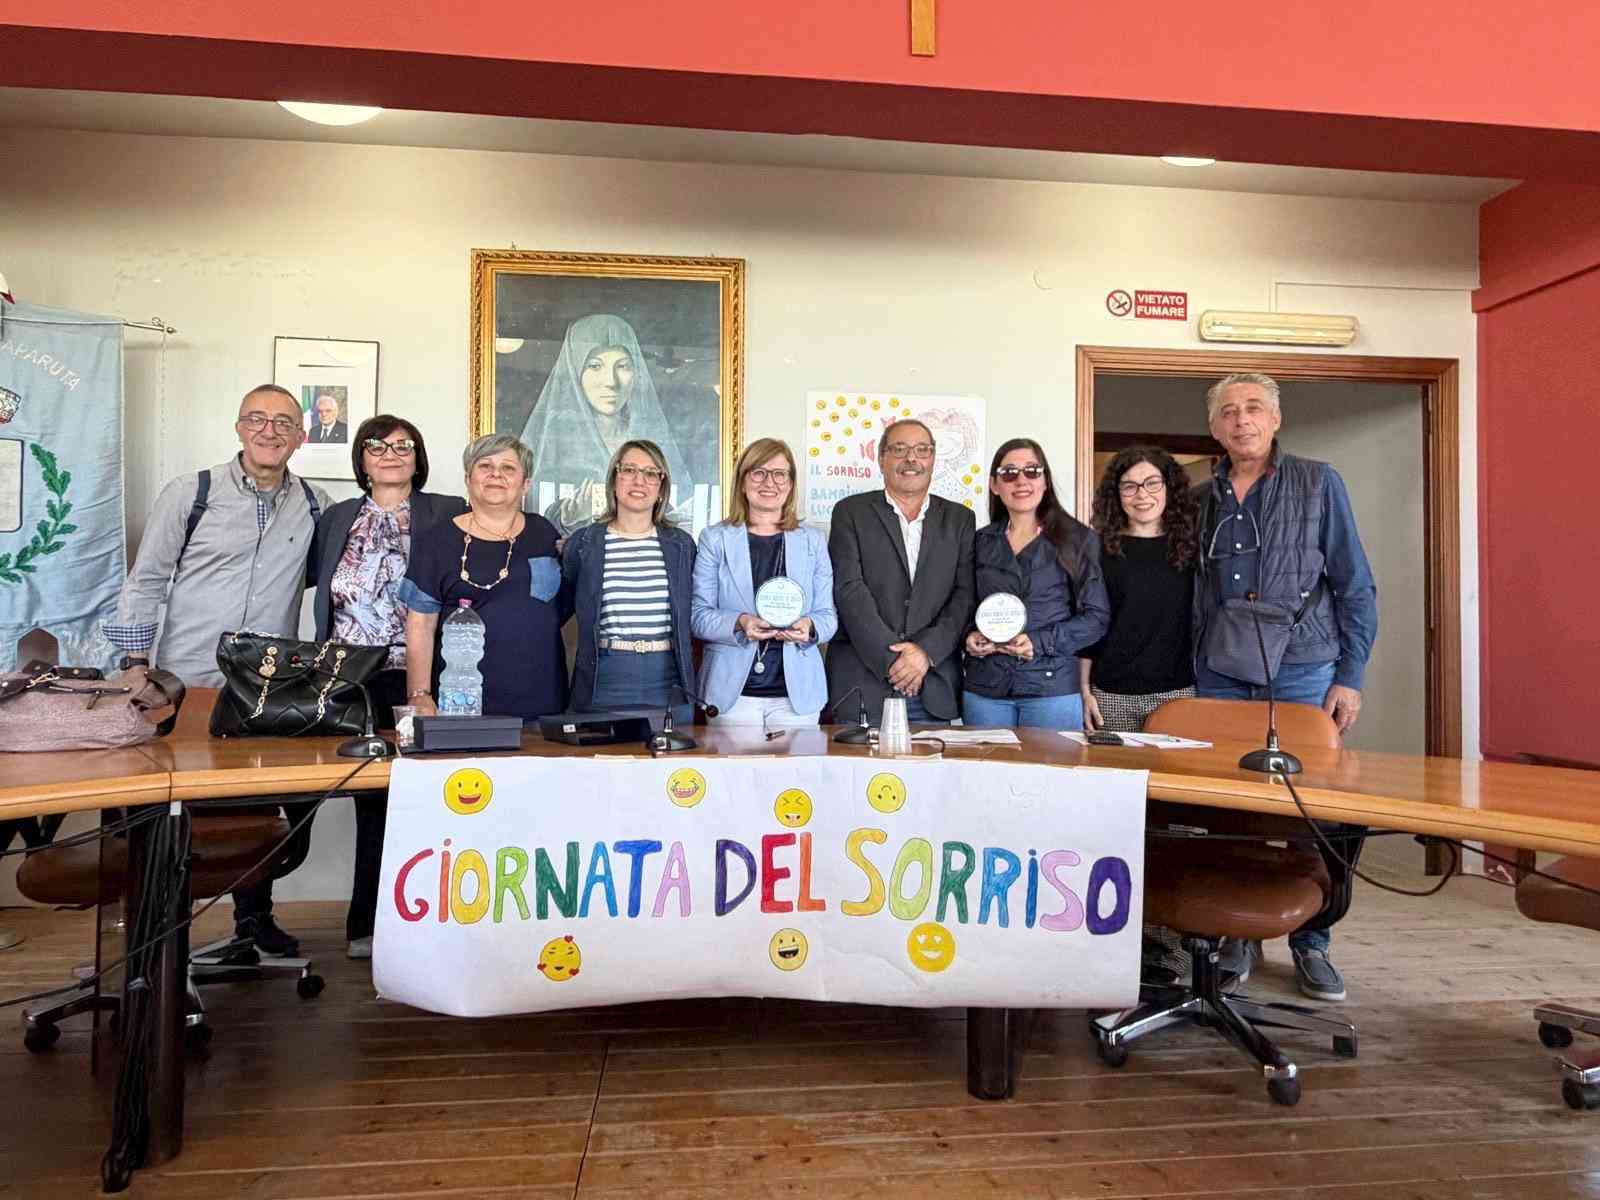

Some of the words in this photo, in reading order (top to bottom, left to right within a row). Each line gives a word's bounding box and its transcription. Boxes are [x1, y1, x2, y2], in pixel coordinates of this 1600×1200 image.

[1137, 294, 1185, 305] VIETATO
[1136, 306, 1185, 317] FUMARE
[715, 831, 827, 917] DEL
